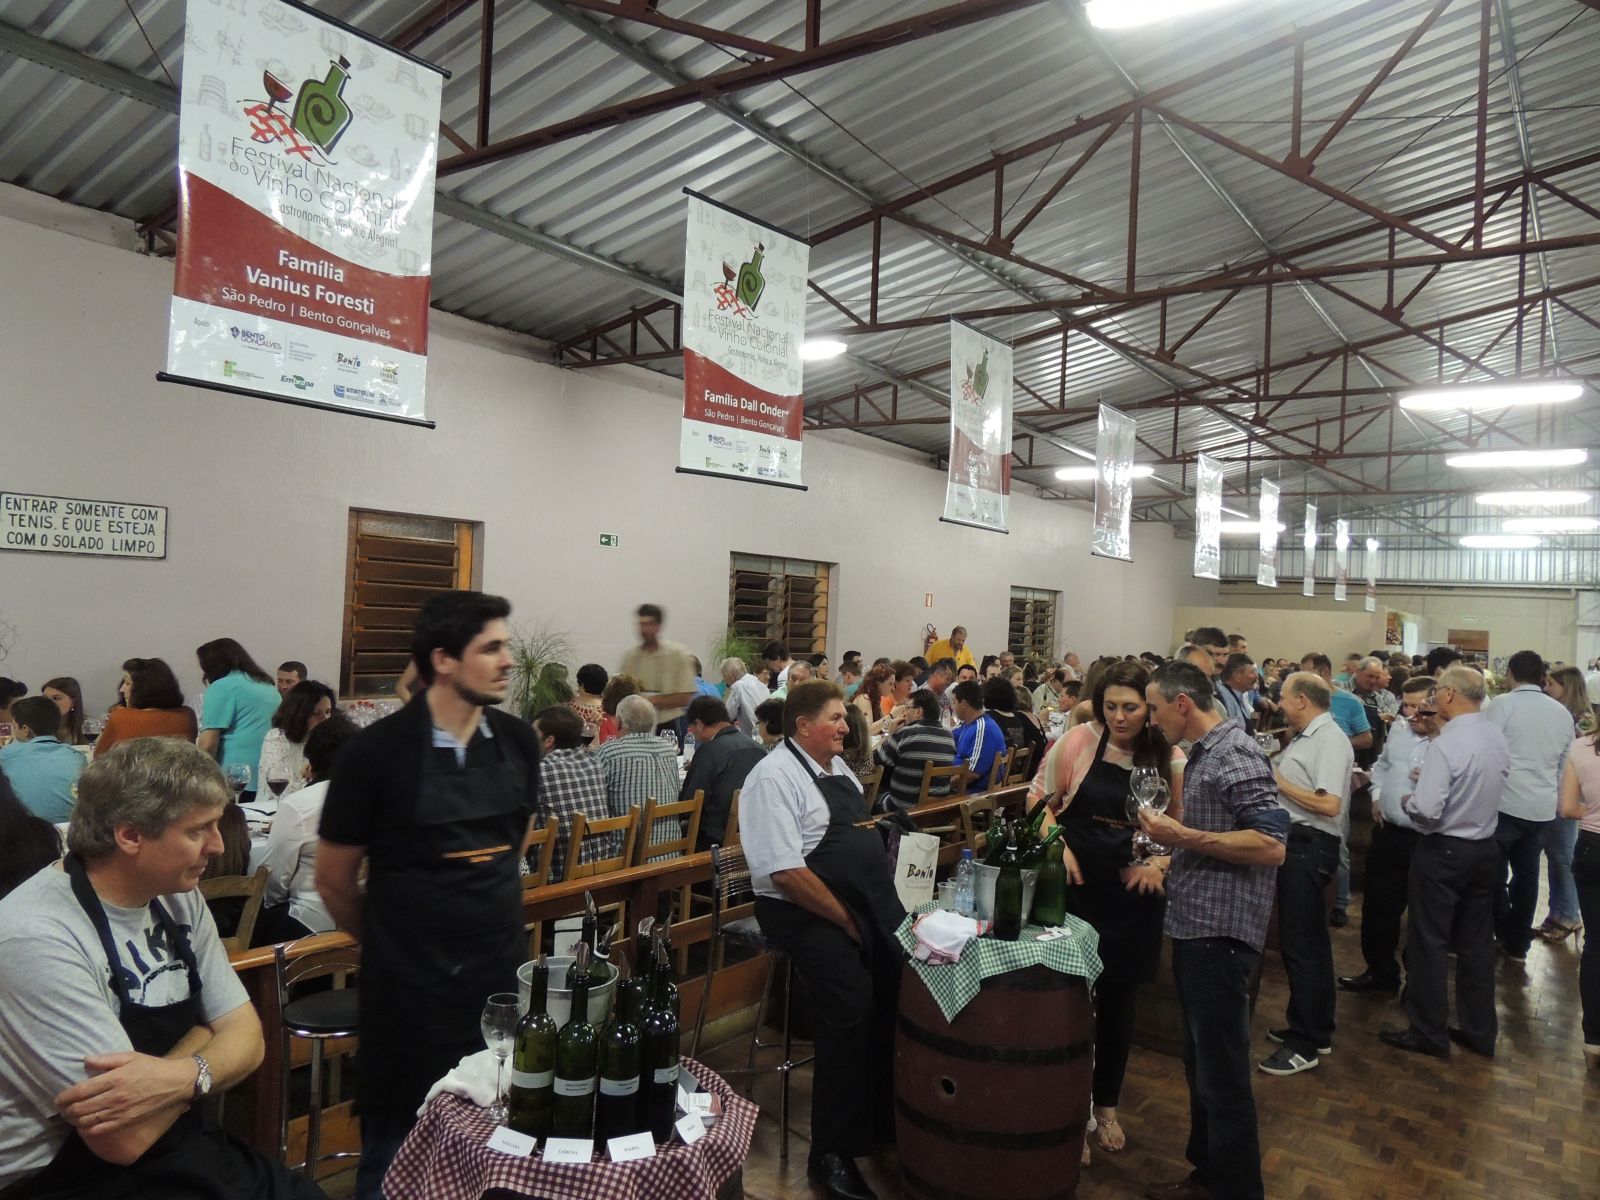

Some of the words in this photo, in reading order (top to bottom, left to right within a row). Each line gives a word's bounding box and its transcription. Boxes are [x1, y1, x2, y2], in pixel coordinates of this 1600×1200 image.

[229, 157, 249, 175] do
[252, 165, 313, 203] Vinho
[231, 136, 310, 182] Festival
[316, 168, 398, 210] Nacional
[279, 199, 332, 229] astronomia,
[367, 228, 398, 249] Alegria!
[278, 249, 345, 283] Família
[246, 265, 310, 298] Vanius
[315, 284, 375, 315] Foresti
[221, 287, 246, 303] São
[249, 293, 286, 313] Pedro
[300, 306, 334, 324] Bento
[336, 316, 392, 340] Gonçalves
[708, 308, 745, 332] Festival
[747, 321, 789, 344] Nacional
[240, 336, 282, 350] GONÇALVES
[241, 329, 265, 341] BENTO
[717, 324, 748, 346] Vinho
[750, 336, 788, 358] Colonial
[704, 389, 738, 408] Família
[740, 397, 758, 413] Dall
[704, 408, 716, 418] São
[717, 411, 735, 422] Pedro
[741, 416, 758, 427] Bento
[5, 497, 58, 514] ENTRAR
[65, 502, 126, 519] SOMENTE
[131, 508, 159, 522] COM
[62, 517, 70, 531] E
[74, 518, 102, 534] QUE
[108, 520, 156, 536] ESTEJA
[7, 531, 36, 546] COM
[52, 534, 104, 550] SOLADO
[112, 538, 155, 554] LIMPO
